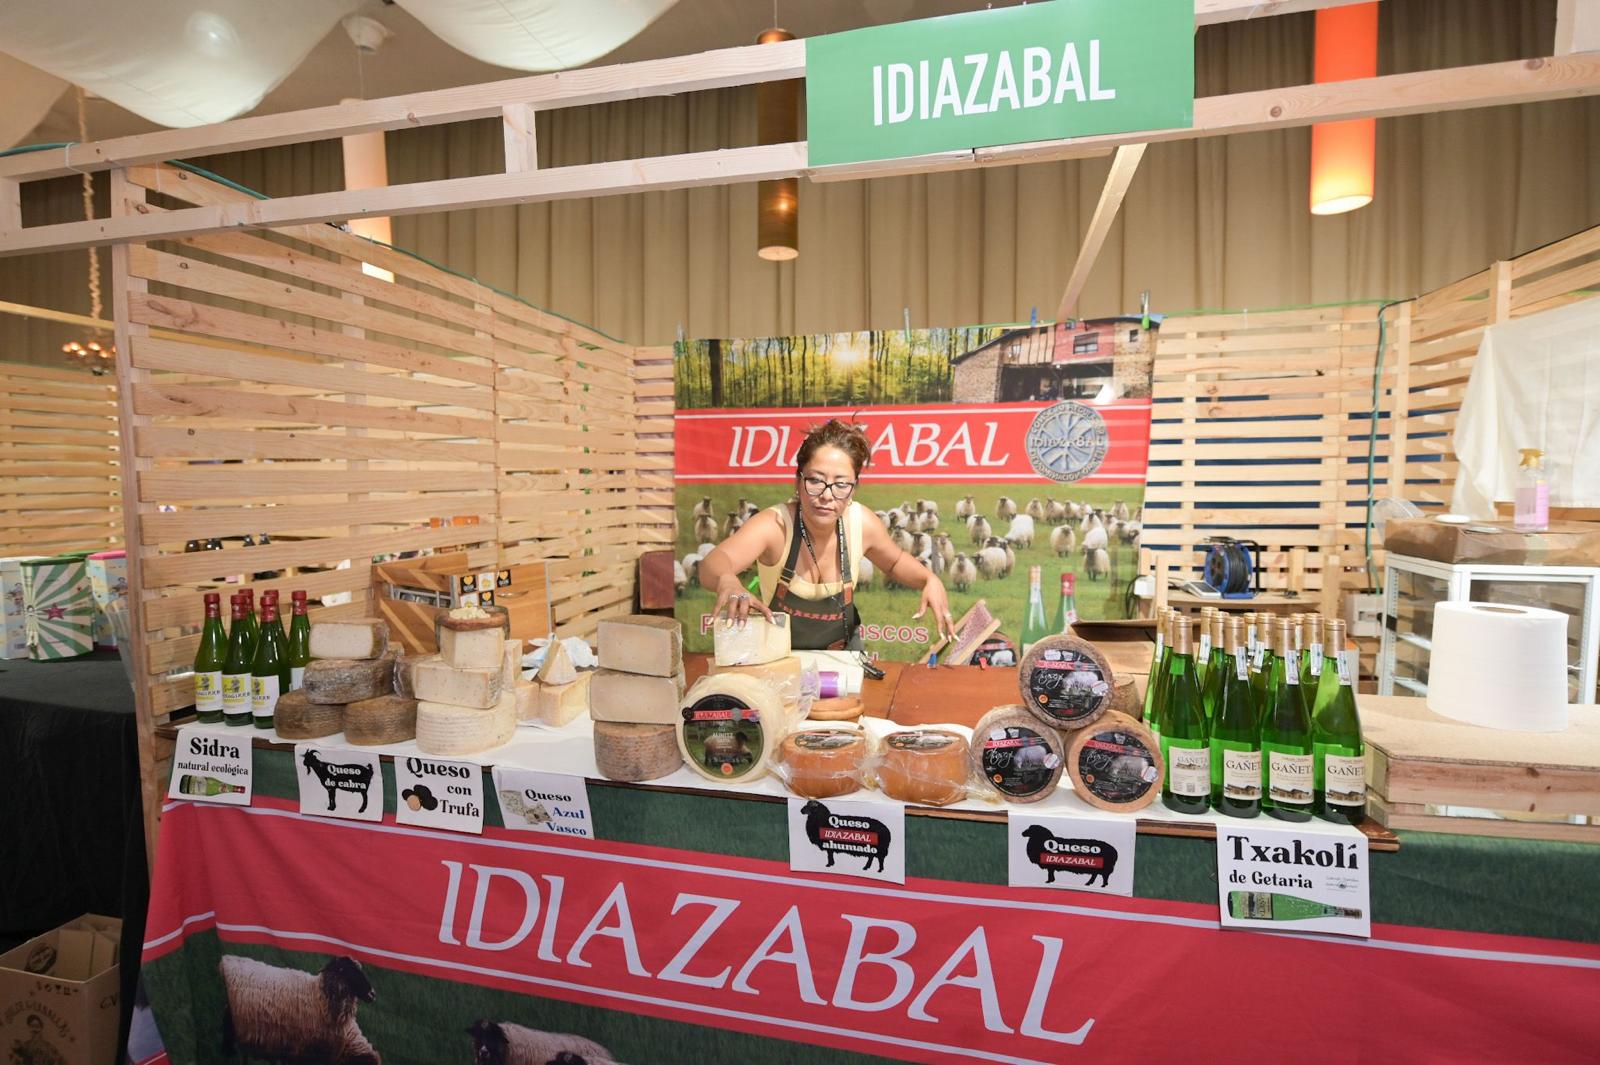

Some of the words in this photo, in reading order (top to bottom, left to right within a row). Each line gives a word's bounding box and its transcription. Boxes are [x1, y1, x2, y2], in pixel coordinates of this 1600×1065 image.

[872, 39, 1116, 126] IDIAZABAL
[728, 421, 1010, 467] IDIABAL
[190, 737, 240, 759] Sidra
[177, 761, 209, 773] natural
[327, 764, 362, 776] Queso
[406, 757, 470, 779] Queso
[324, 778, 336, 787] de
[338, 780, 366, 789] cabra
[447, 785, 472, 796] con
[525, 788, 572, 802] Queso
[439, 799, 480, 817] Trufa
[552, 806, 585, 819] Azul
[546, 821, 587, 836] Vasco
[828, 815, 870, 829] Queso
[824, 830, 872, 842] IDIAZABAL
[822, 840, 878, 854] ahumado
[1043, 839, 1101, 853] Queso
[1226, 835, 1359, 870] Txakolí
[1046, 855, 1096, 866] IDIAZABAL
[1229, 869, 1246, 884] de
[1251, 871, 1313, 889] Getaria
[438, 860, 1097, 1045] IDIAZABAL
